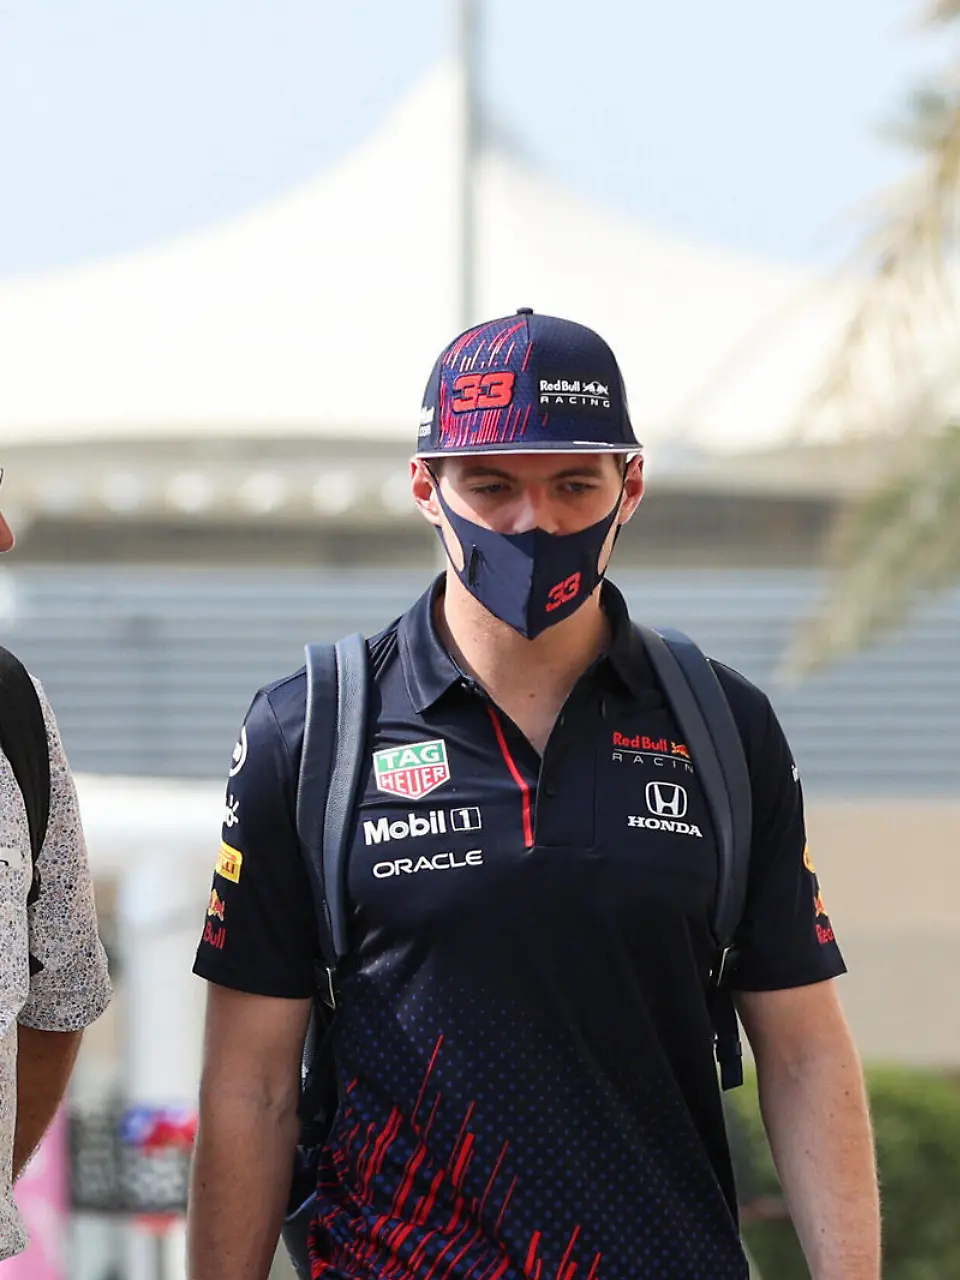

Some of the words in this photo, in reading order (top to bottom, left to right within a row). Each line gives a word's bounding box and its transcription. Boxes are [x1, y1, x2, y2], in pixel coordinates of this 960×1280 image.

[452, 371, 516, 414] 33
[539, 379, 561, 392] Red
[561, 380, 580, 393] Bull
[539, 396, 611, 408] RACING
[545, 571, 581, 612] 33
[613, 731, 640, 748] Red
[641, 736, 668, 752] Bull
[378, 744, 440, 769] TAG
[612, 752, 694, 774] RACIN
[379, 765, 446, 798] HEUER
[363, 809, 446, 845] Mobil
[627, 816, 703, 838] HONDA
[372, 850, 484, 878] ORACLE
[203, 921, 227, 949] Bull
